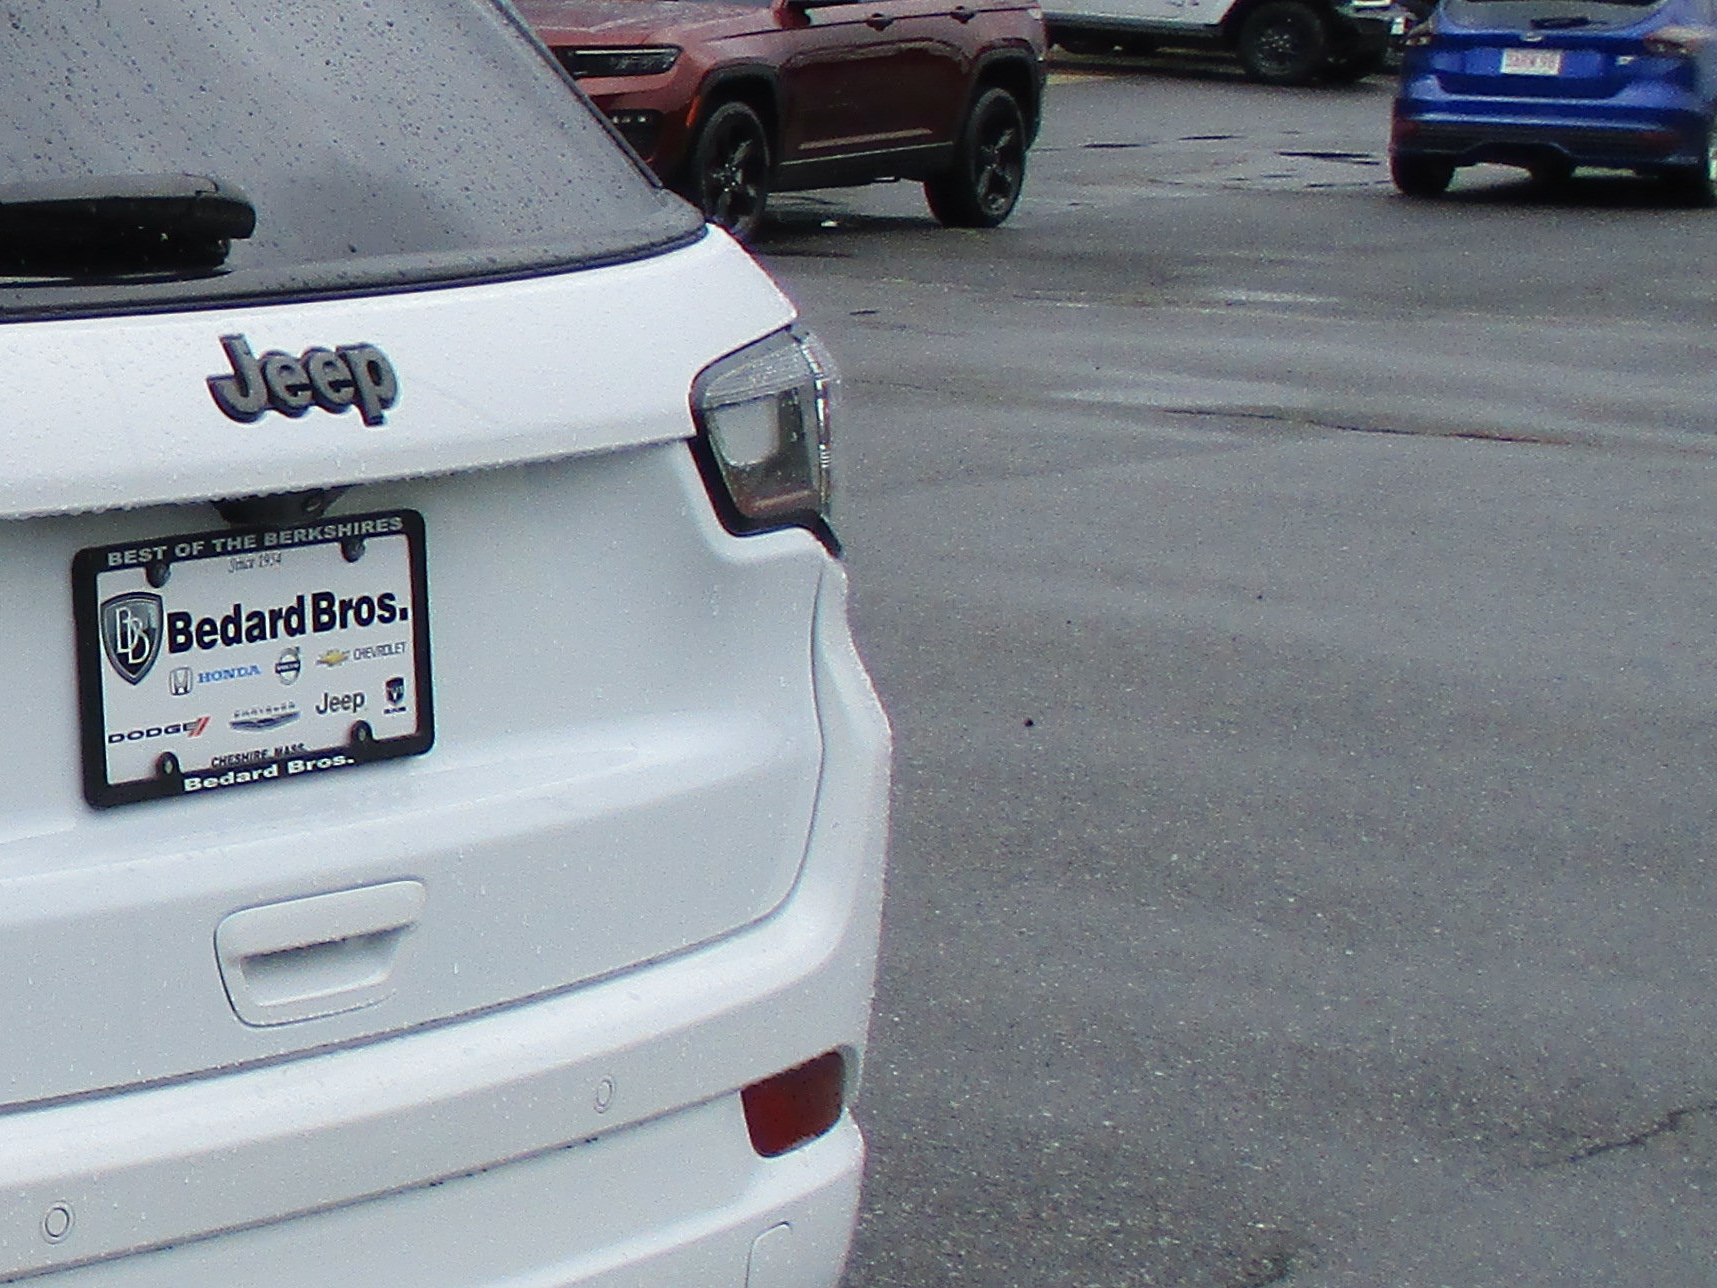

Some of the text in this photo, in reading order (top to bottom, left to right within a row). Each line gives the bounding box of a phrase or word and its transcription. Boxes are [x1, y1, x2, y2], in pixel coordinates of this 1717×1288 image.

[206, 334, 399, 427] Jeep
[107, 516, 404, 566] BEST OF THE BERKSHIRES
[353, 642, 406, 661] CHEVROLET
[198, 665, 261, 683] HONDA
[315, 692, 366, 715] Jeep
[108, 721, 199, 744] DODGE
[184, 754, 355, 792] Bedard Bros.
